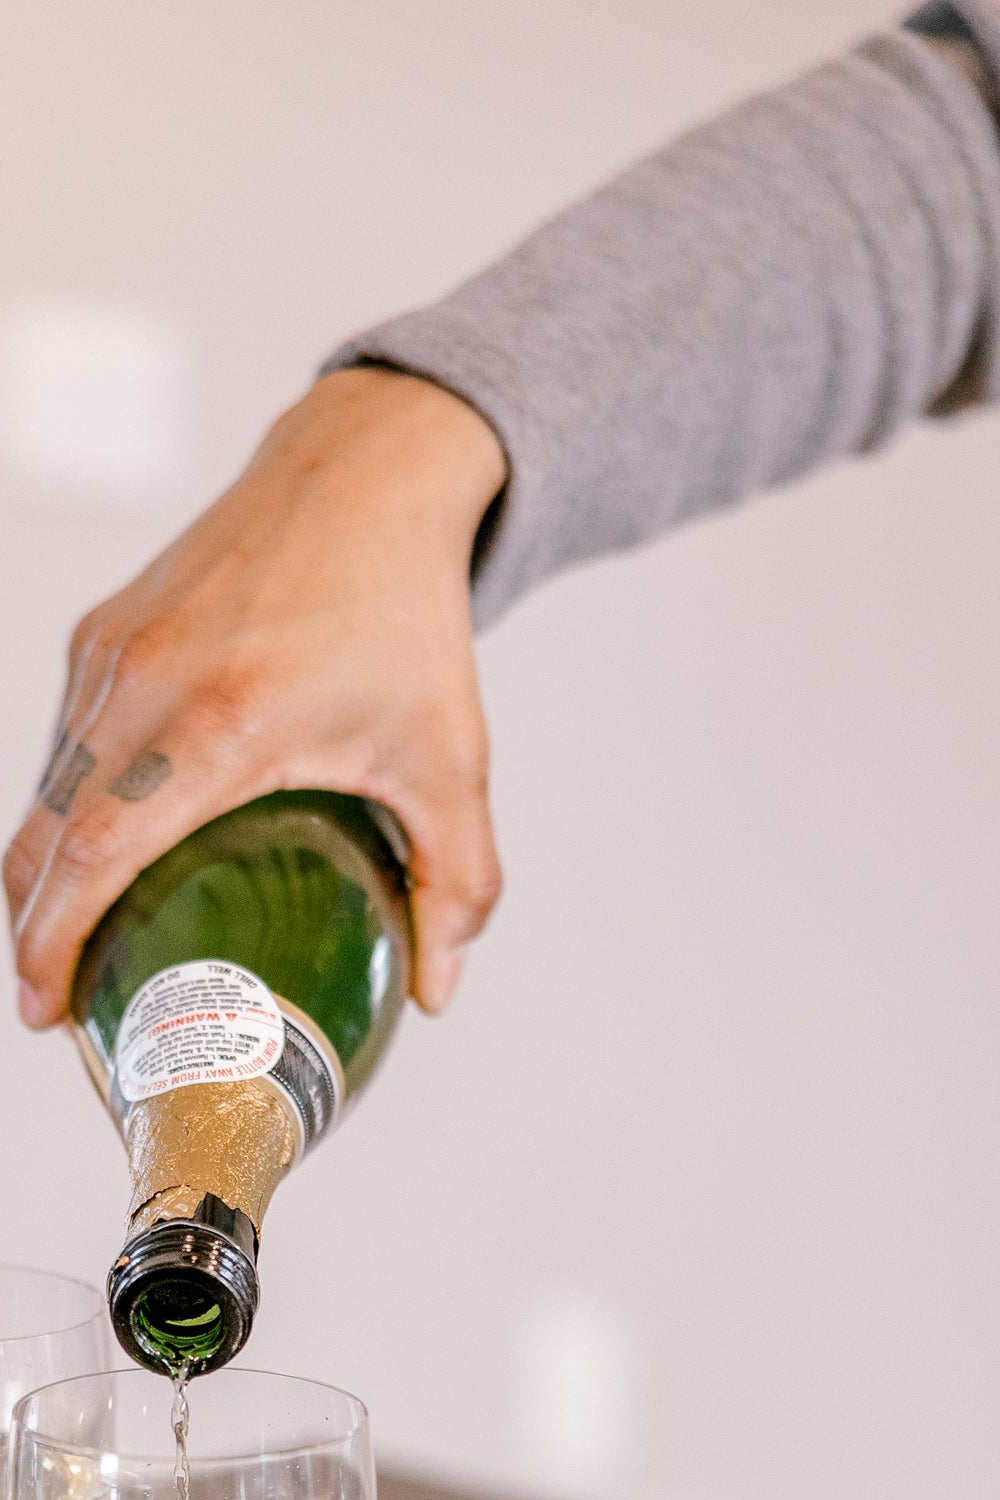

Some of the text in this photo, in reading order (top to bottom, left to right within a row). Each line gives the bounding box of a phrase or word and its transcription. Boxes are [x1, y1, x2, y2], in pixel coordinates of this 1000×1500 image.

[208, 966, 257, 989] CHILL WELL
[148, 1013, 219, 1039] WARNING!
[235, 1041, 254, 1050] TWIST
[262, 1038, 278, 1062] POINT
[205, 1068, 233, 1078] AWAY
[235, 1057, 266, 1076] BOTTLE
[172, 1072, 200, 1085] FROM
[146, 1080, 168, 1094] SELF
